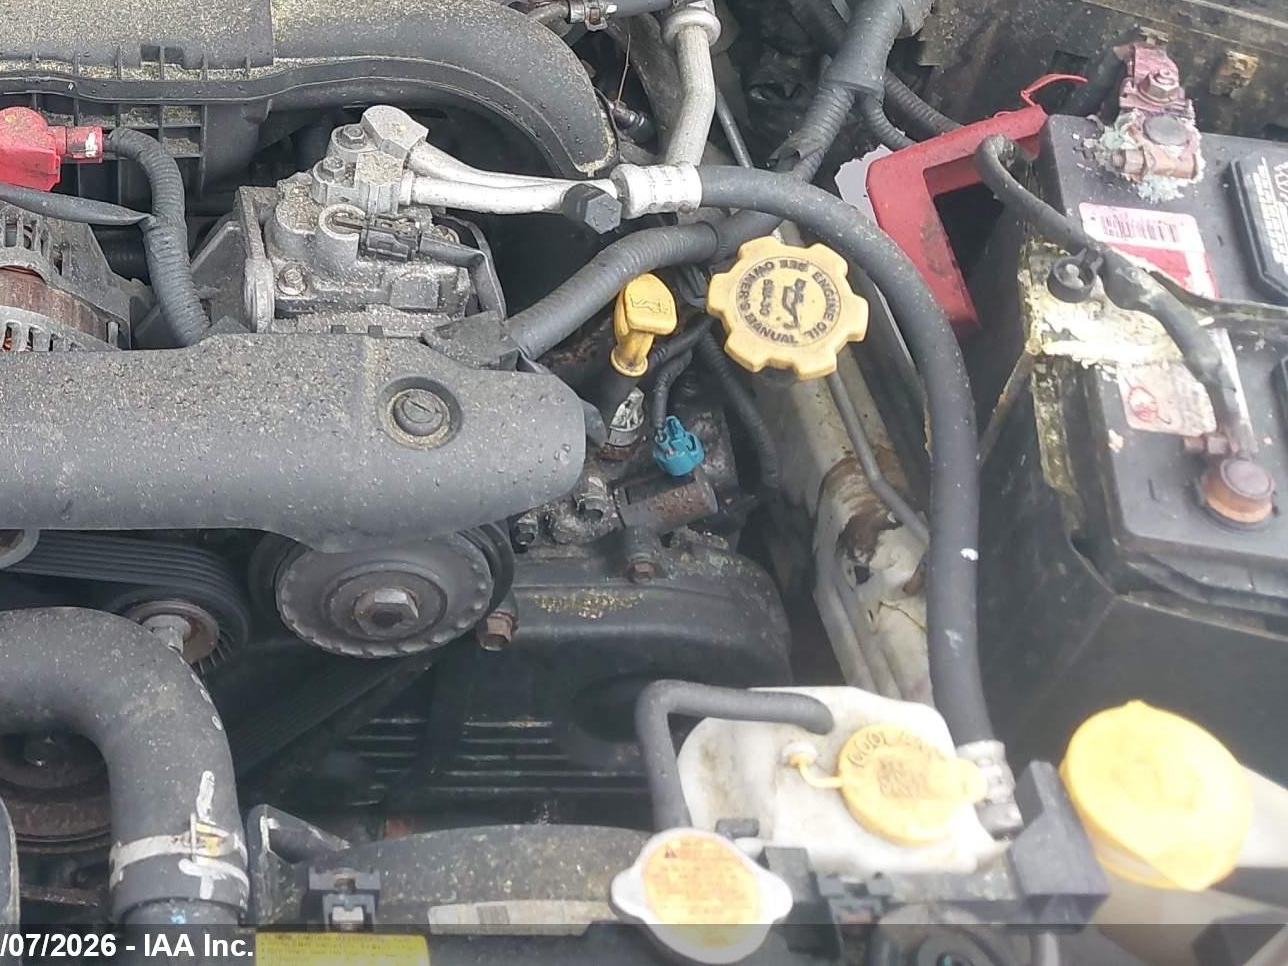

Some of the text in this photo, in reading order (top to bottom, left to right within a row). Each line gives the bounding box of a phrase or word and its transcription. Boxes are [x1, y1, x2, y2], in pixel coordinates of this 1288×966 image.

[738, 261, 775, 312] OWNER'S
[805, 271, 838, 339] ENGINE OIL
[744, 312, 799, 344] MANUAL
